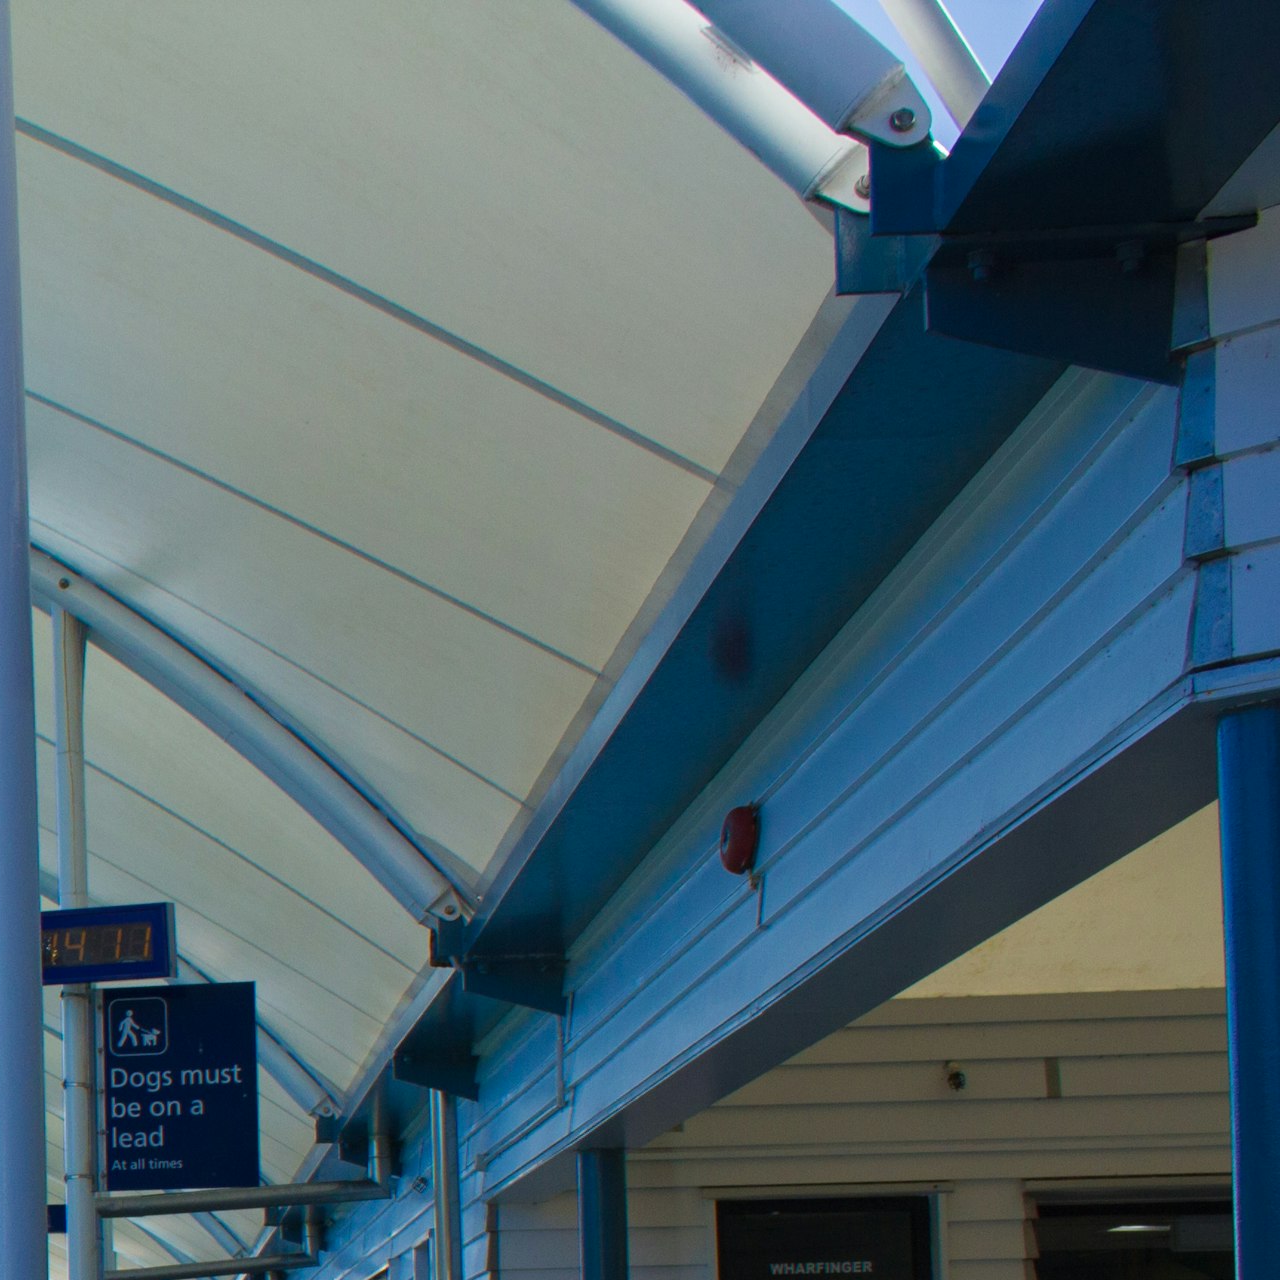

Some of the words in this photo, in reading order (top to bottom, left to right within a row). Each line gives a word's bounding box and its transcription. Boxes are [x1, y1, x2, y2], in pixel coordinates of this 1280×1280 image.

[110, 1067, 174, 1093] Dogs
[180, 1063, 243, 1086] must
[110, 1096, 142, 1118] be
[148, 1100, 182, 1117] on
[189, 1099, 205, 1116] a
[111, 1124, 165, 1149] lead
[111, 1159, 127, 1170] At
[129, 1158, 146, 1170] all
[148, 1157, 184, 1170] times
[769, 1260, 874, 1276] WHARFINGER
